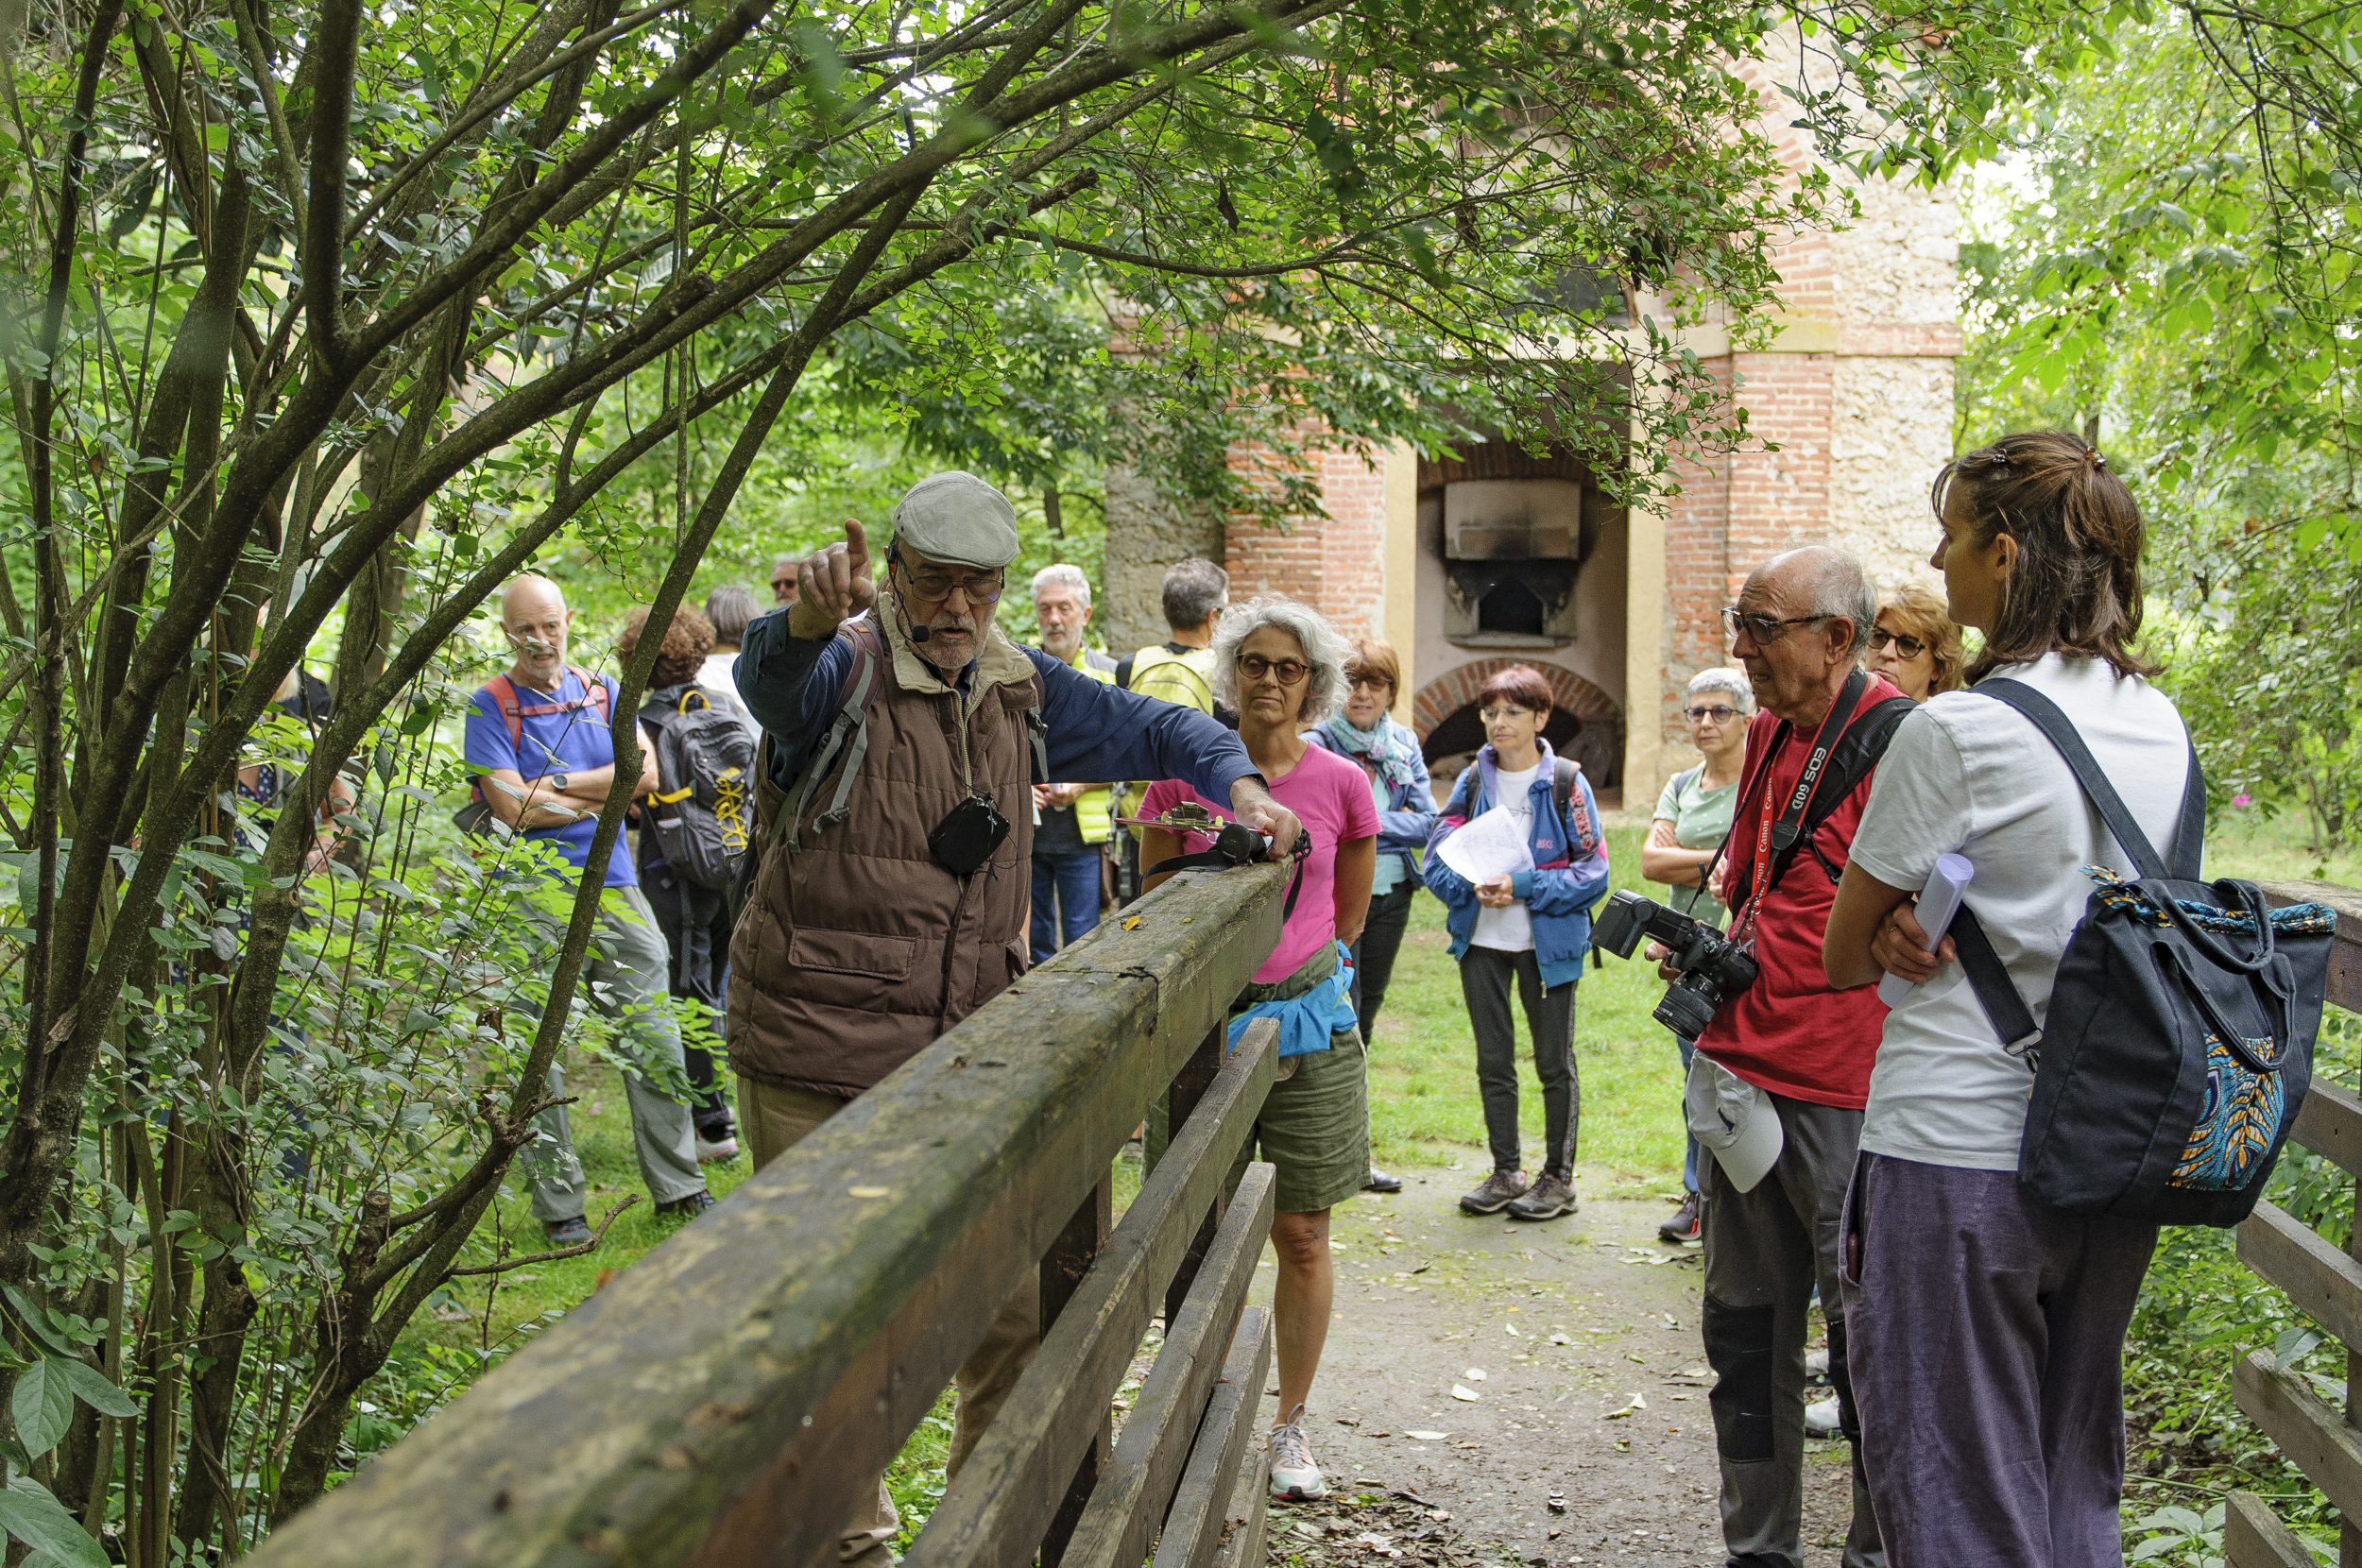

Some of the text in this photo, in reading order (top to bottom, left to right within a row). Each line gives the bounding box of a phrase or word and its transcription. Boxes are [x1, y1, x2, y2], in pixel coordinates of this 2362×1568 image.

[1791, 747, 1827, 810] EOS 60D
[1758, 820, 1770, 853] Canon
